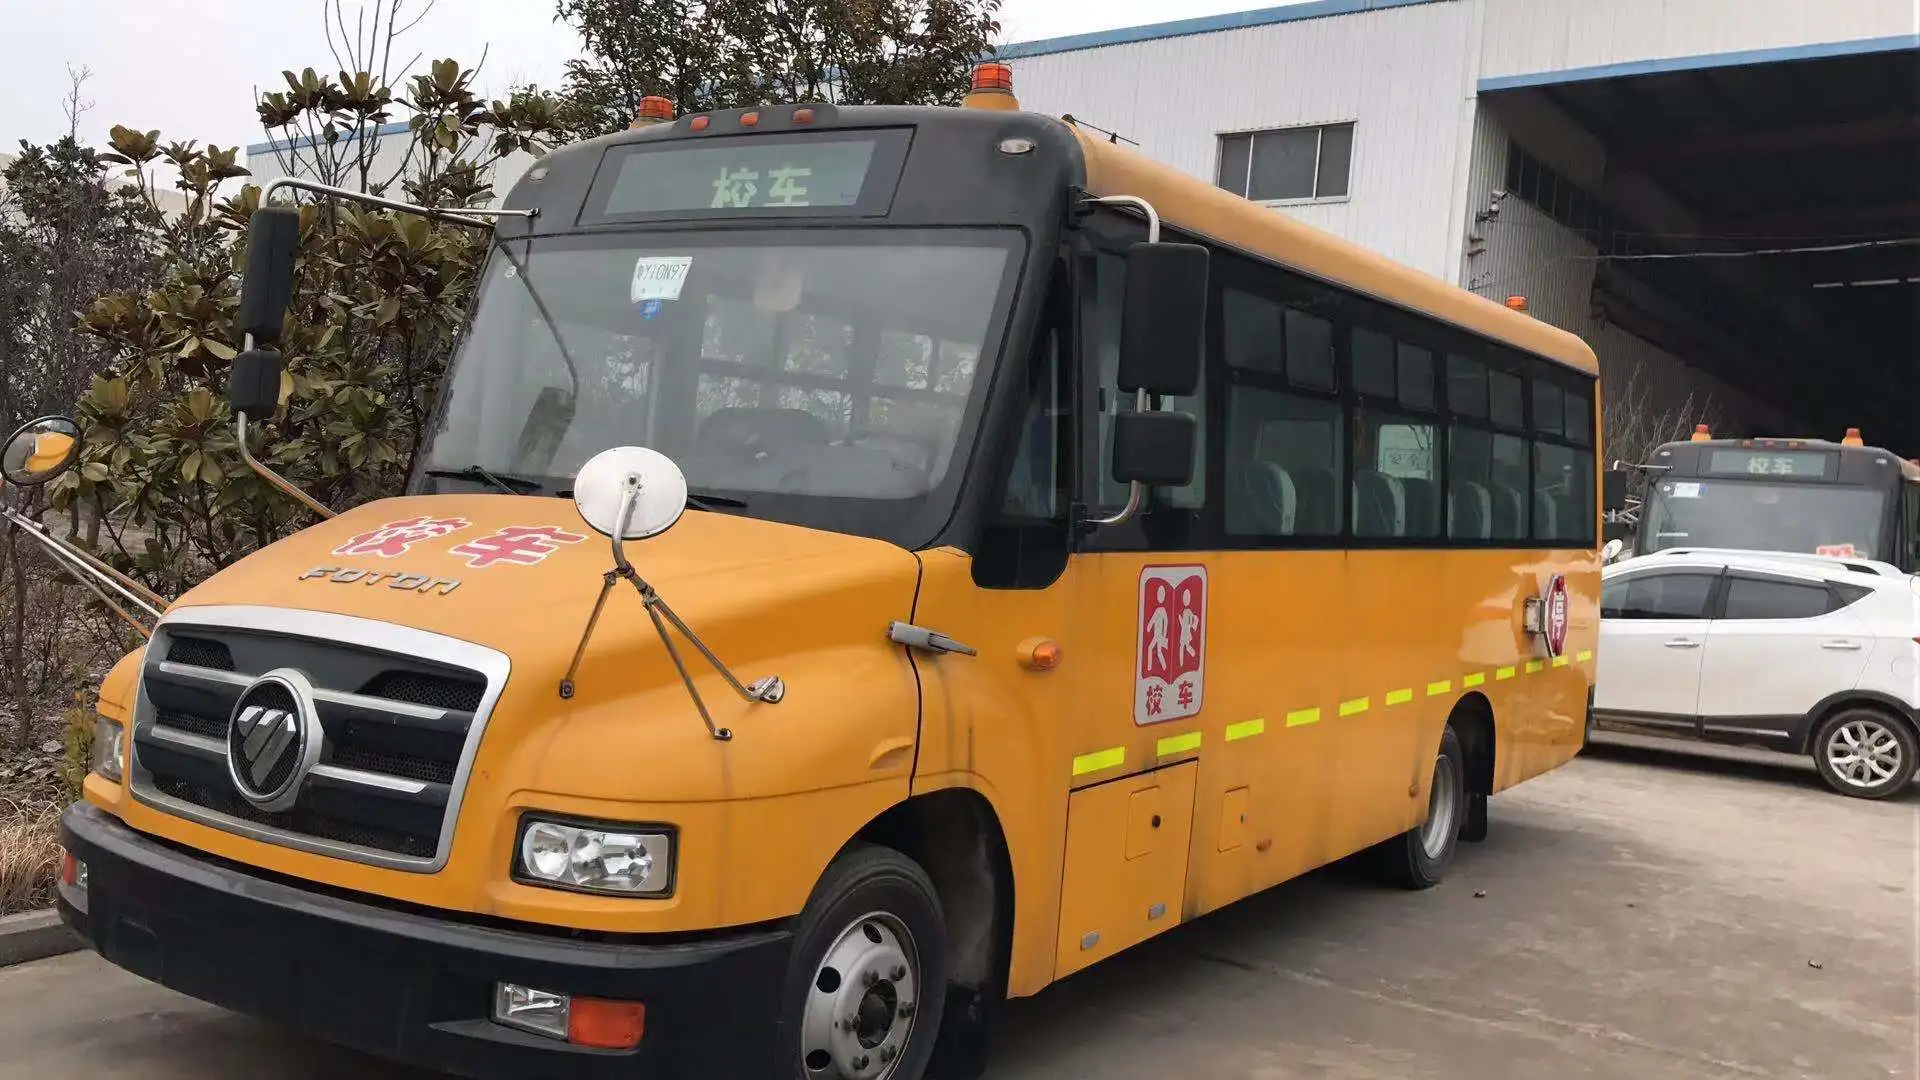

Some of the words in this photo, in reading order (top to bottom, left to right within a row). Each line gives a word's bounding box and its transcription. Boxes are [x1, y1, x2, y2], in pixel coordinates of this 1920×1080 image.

[710, 167, 812, 209] 校车
[1748, 457, 1794, 475] 校车
[331, 516, 589, 568] 校车
[298, 566, 462, 595] FOTON
[1146, 679, 1194, 716] 校车
